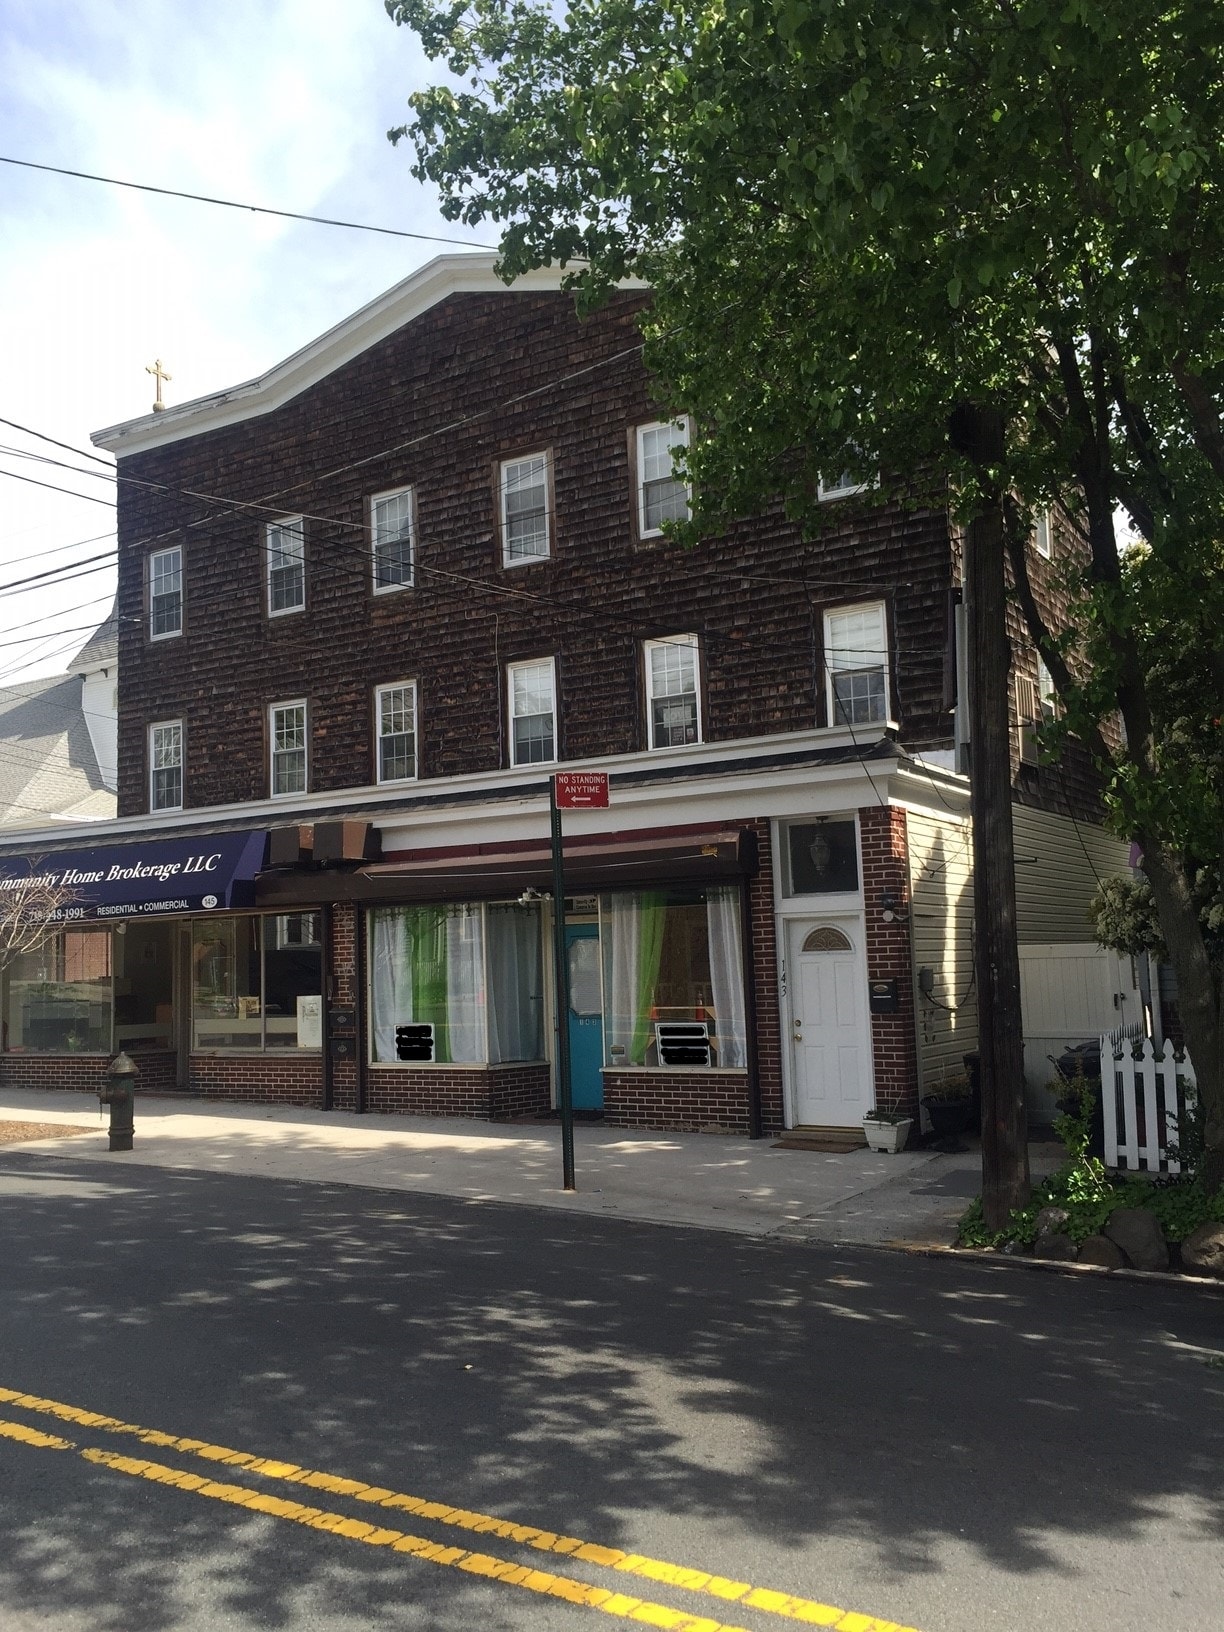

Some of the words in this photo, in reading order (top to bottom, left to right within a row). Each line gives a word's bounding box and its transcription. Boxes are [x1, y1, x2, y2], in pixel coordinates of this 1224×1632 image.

[558, 776, 569, 784] NO
[571, 776, 606, 784] STANDING
[564, 785, 601, 794] ANYTIME
[0, 872, 60, 892] mmunity
[60, 868, 104, 886] Home
[105, 861, 181, 882] Brokerage
[182, 853, 222, 874] LLC
[97, 904, 138, 916] RESIDENTIAL
[143, 899, 189, 912] COMMERCIAL
[204, 897, 216, 906] 145
